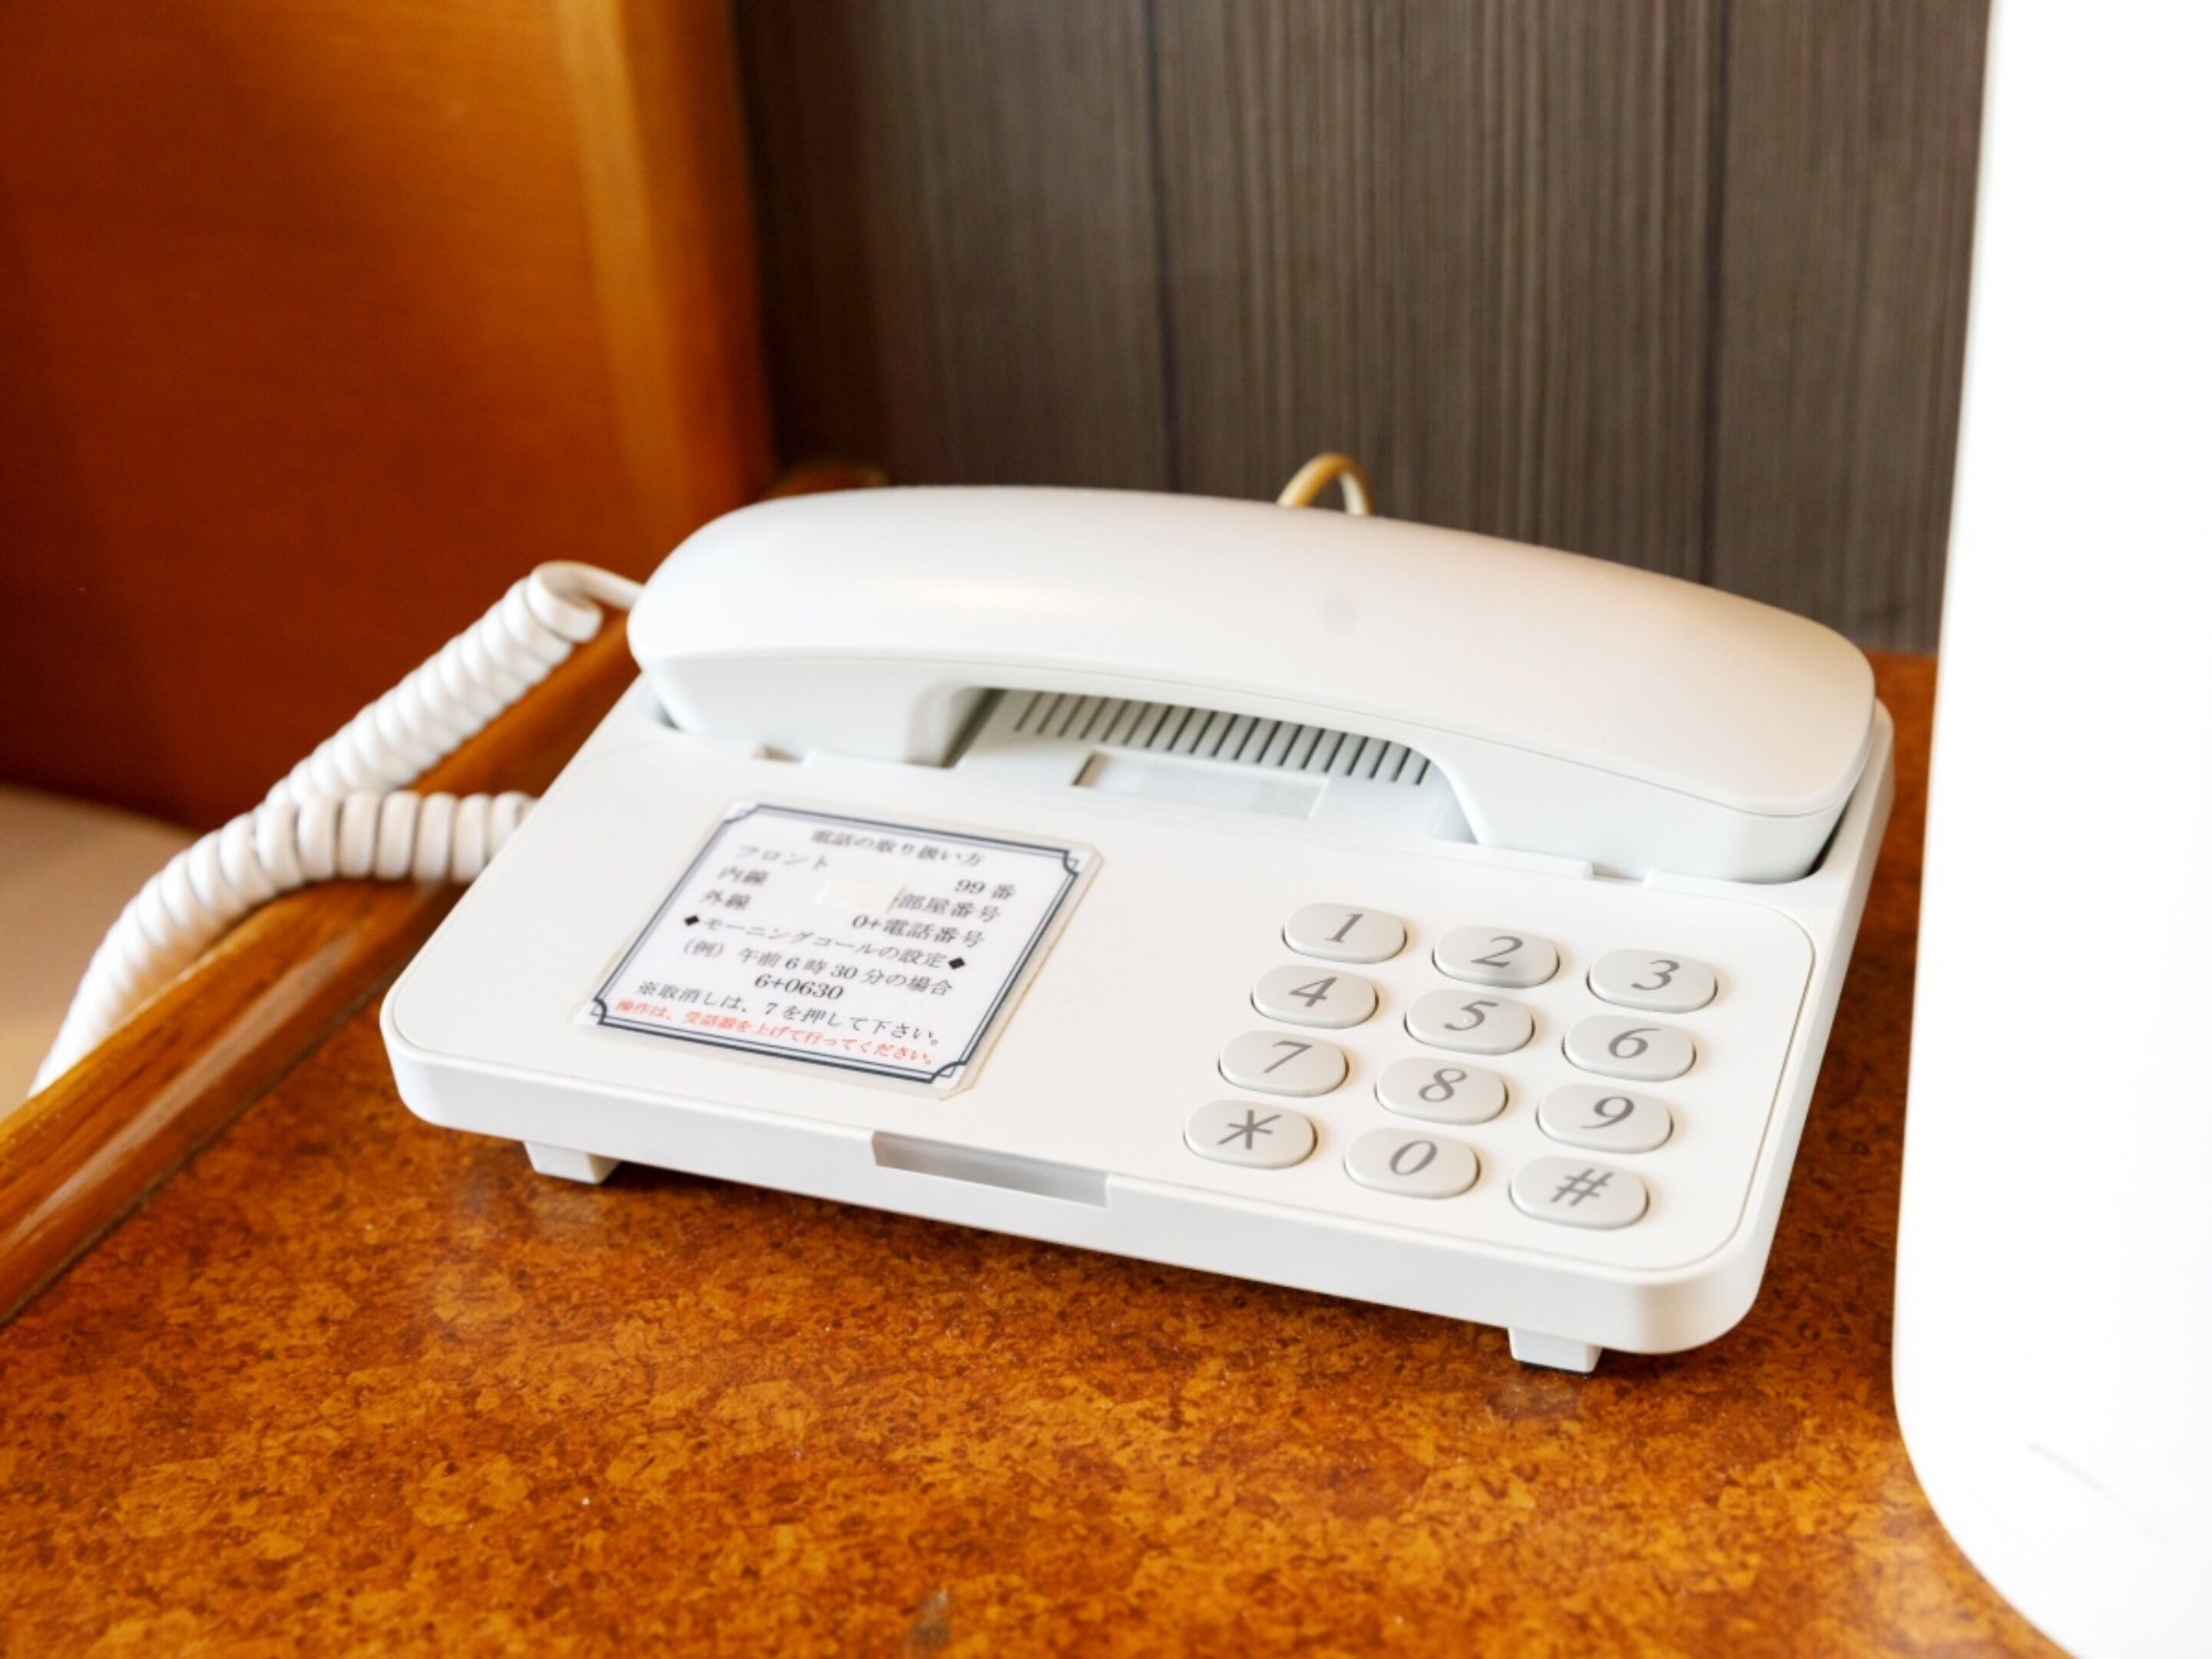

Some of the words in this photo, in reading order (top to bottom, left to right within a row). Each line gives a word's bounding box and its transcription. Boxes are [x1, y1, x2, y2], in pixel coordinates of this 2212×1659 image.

[737, 844, 828, 870] フロント
[717, 866, 769, 886] 内線
[699, 889, 751, 910] 外線
[1324, 912, 1364, 944] 1
[1471, 935, 1524, 969] 2
[754, 973, 844, 1000] 6+0630
[1631, 959, 1681, 991] 3
[1289, 976, 1337, 1008] 4
[1444, 1000, 1500, 1031] 5
[1263, 1040, 1313, 1074] 7
[1608, 1028, 1660, 1059] 6
[1419, 1068, 1468, 1101] 8
[1581, 1096, 1635, 1130] 9
[1389, 1140, 1438, 1176] 0
[1551, 1168, 1613, 1206] #
